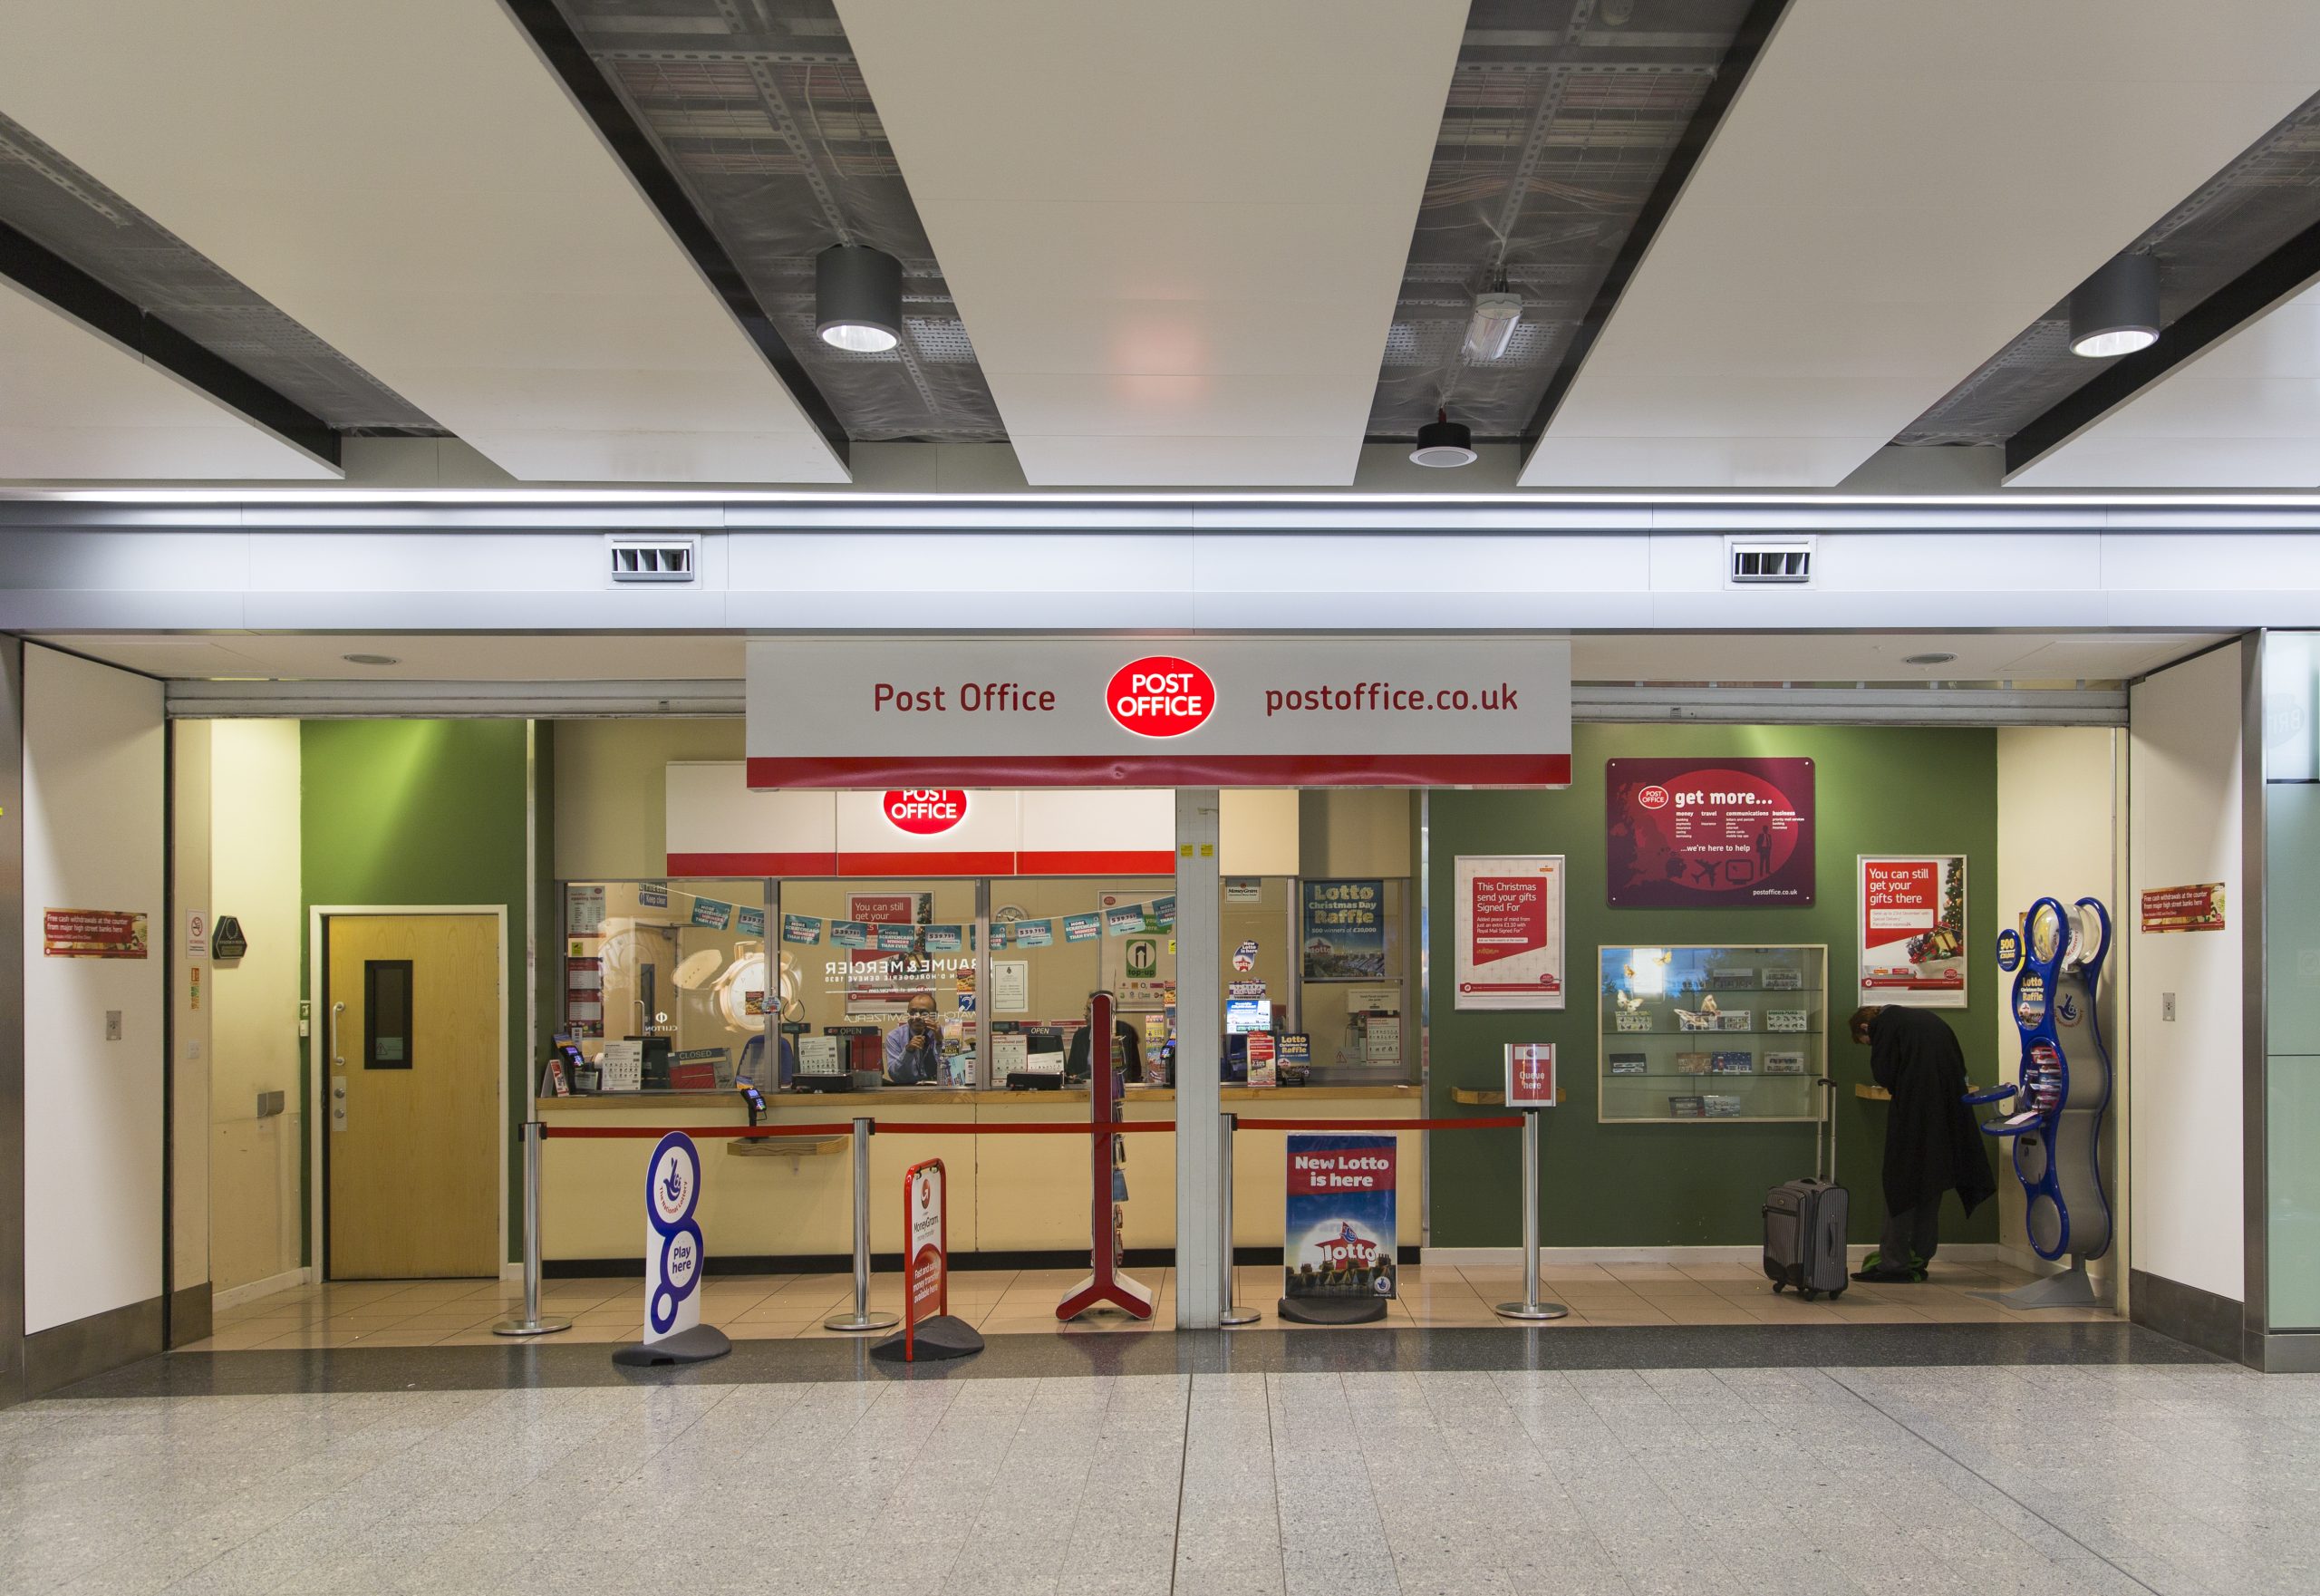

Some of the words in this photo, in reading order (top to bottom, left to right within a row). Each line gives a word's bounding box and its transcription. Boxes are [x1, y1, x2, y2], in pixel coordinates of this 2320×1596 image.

[1132, 673, 1194, 693] POST
[875, 683, 946, 711] Post
[960, 682, 1056, 711] Office
[1265, 682, 1518, 717] postoffice.co.uk
[1116, 695, 1202, 717] OFFICE
[904, 789, 947, 801] POST
[1675, 790, 1705, 808] get
[1710, 792, 1773, 805] more...
[891, 802, 957, 819] OFFICE
[1735, 845, 1751, 853] help
[1870, 868, 1888, 879] You
[1891, 870, 1909, 879] can
[1912, 868, 1929, 879] still
[1314, 885, 1374, 900] Lotto
[1477, 882, 1494, 891] This
[1496, 882, 1537, 891] Christmas
[1753, 888, 1798, 896] postoffice.co.uk
[1870, 881, 1886, 893] get
[1889, 882, 1912, 893] your
[645, 895, 655, 904] Keep
[656, 896, 666, 904] clear
[1477, 893, 1496, 902] send
[1498, 894, 1516, 903] your
[1519, 893, 1537, 903] gifts
[1870, 893, 1893, 906] gifts
[1896, 894, 1922, 904] there
[855, 903, 870, 912] You
[890, 903, 904, 912] still
[1309, 901, 1358, 909] Christmas
[1358, 902, 1377, 910] Day
[1477, 903, 1504, 914] Signed
[1506, 903, 1520, 912] For
[856, 912, 868, 922] get
[870, 913, 889, 922] your
[1314, 909, 1374, 924] Raffle
[60, 924, 73, 932] major
[74, 924, 83, 933] high
[2000, 938, 2015, 950] 500
[2023, 977, 2043, 987] Lotto
[2022, 992, 2043, 1001] Raffle
[680, 1050, 711, 1059] CLOSED
[1519, 1071, 1545, 1079] Queue
[1523, 1081, 1542, 1089] here
[1295, 1156, 1336, 1170] New
[1338, 1156, 1389, 1170] Lotto
[1310, 1171, 1327, 1186] is
[1329, 1173, 1374, 1187] here
[662, 1200, 679, 1214] National
[678, 1181, 688, 1208] Lottery
[914, 1215, 939, 1233] MoneyGram
[673, 1246, 691, 1260] Play
[1324, 1243, 1377, 1262] lotto
[672, 1260, 691, 1274] here
[914, 1268, 923, 1279] Fast
[914, 1279, 925, 1292] money
[914, 1288, 930, 1303] available
[929, 1283, 939, 1294] here
